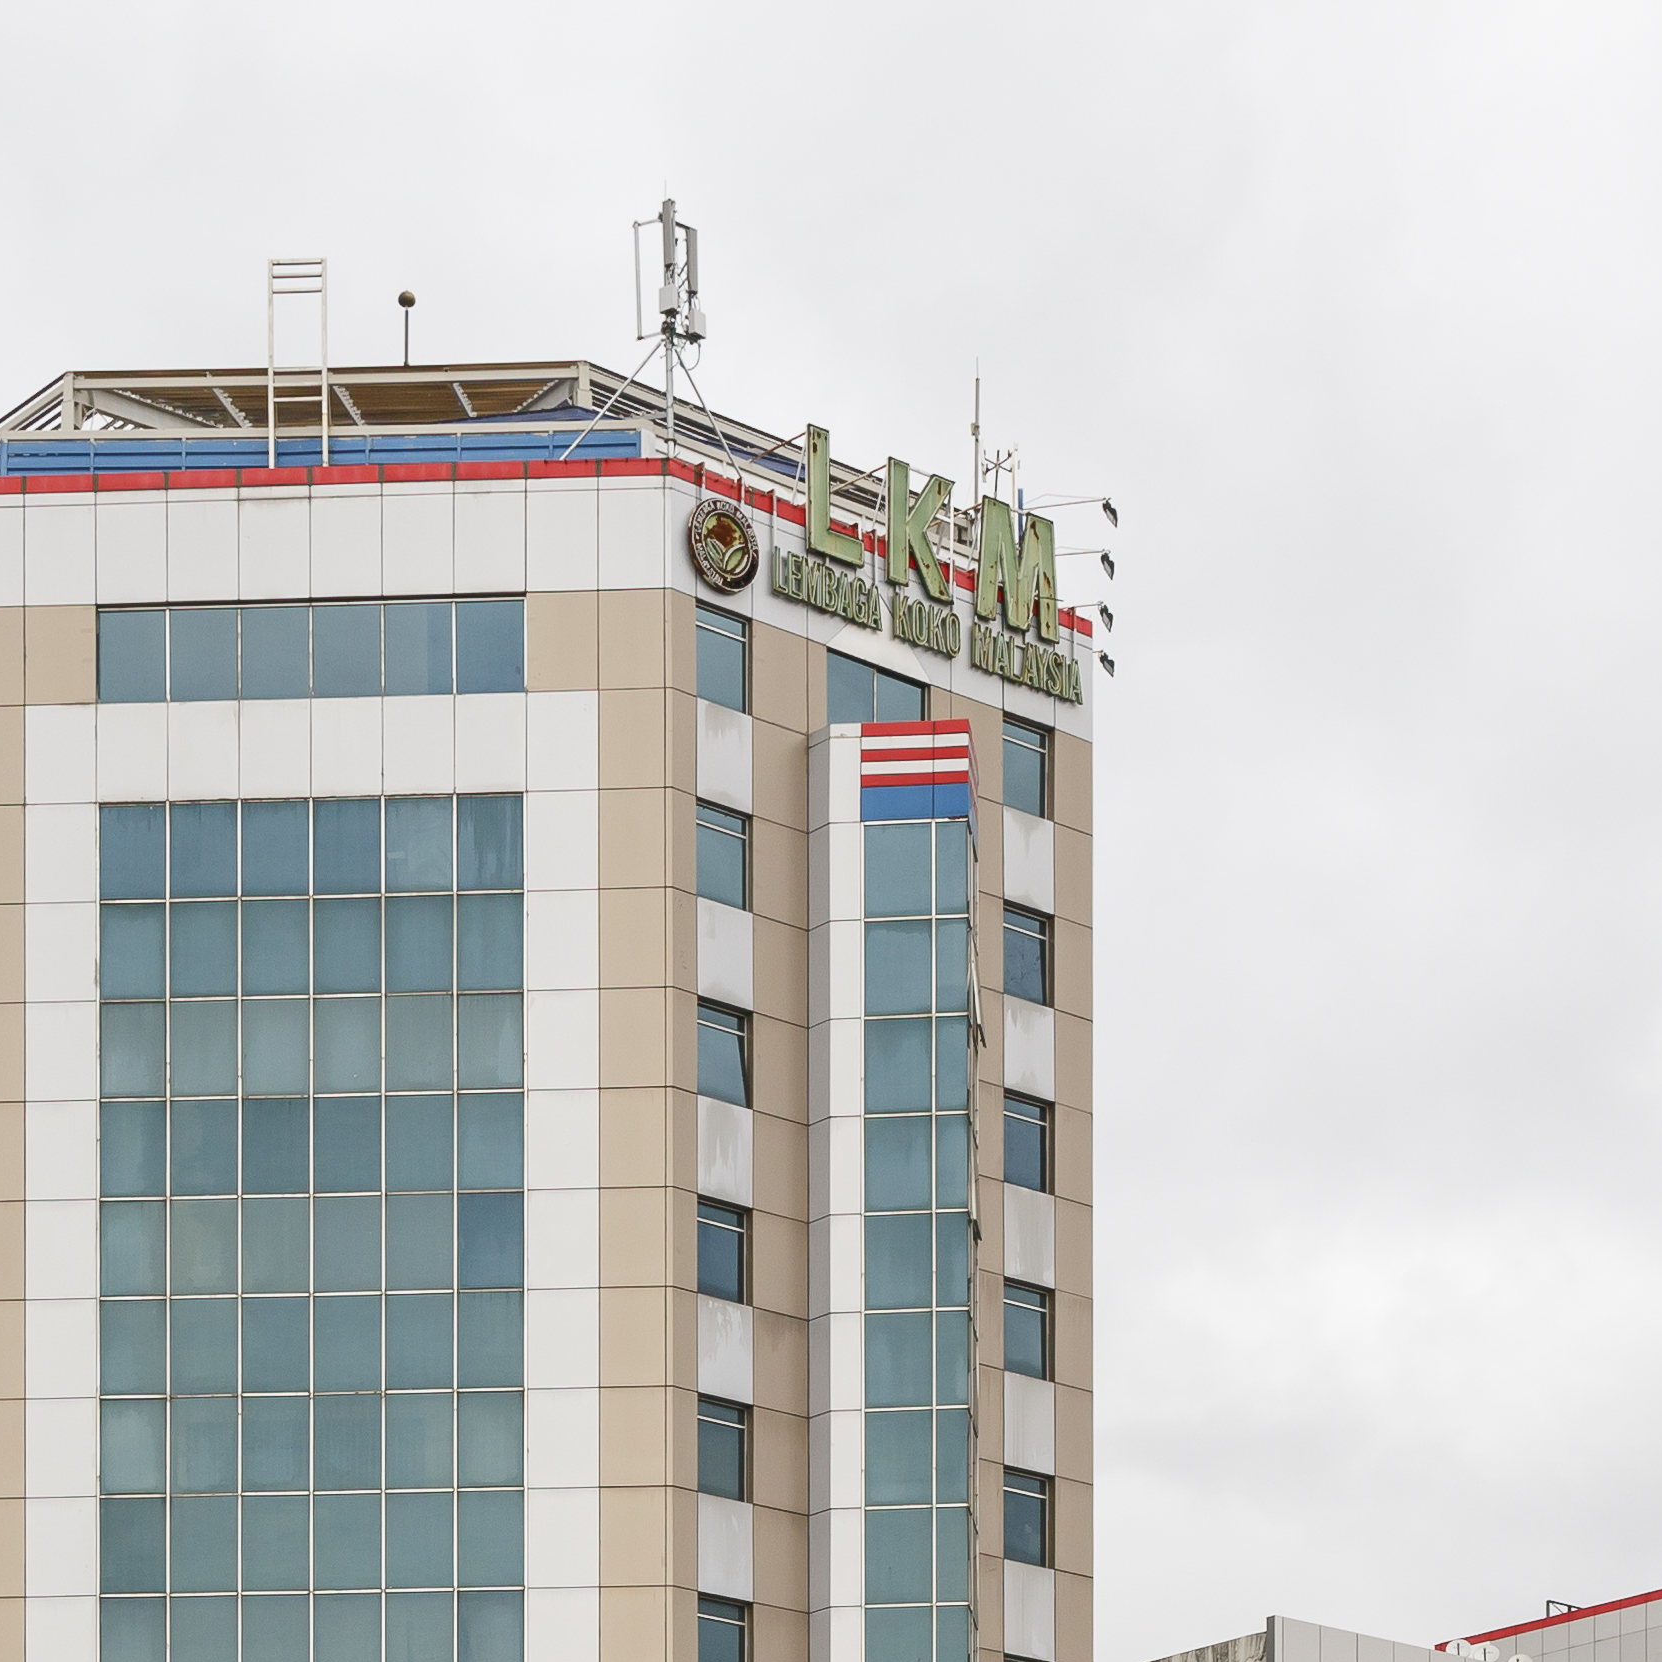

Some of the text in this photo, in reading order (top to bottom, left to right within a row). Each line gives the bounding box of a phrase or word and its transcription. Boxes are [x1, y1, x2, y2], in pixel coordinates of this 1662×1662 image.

[772, 545, 1084, 705] LEMBAGA KOKO MALAYSIA
[806, 423, 1060, 644] LKM
